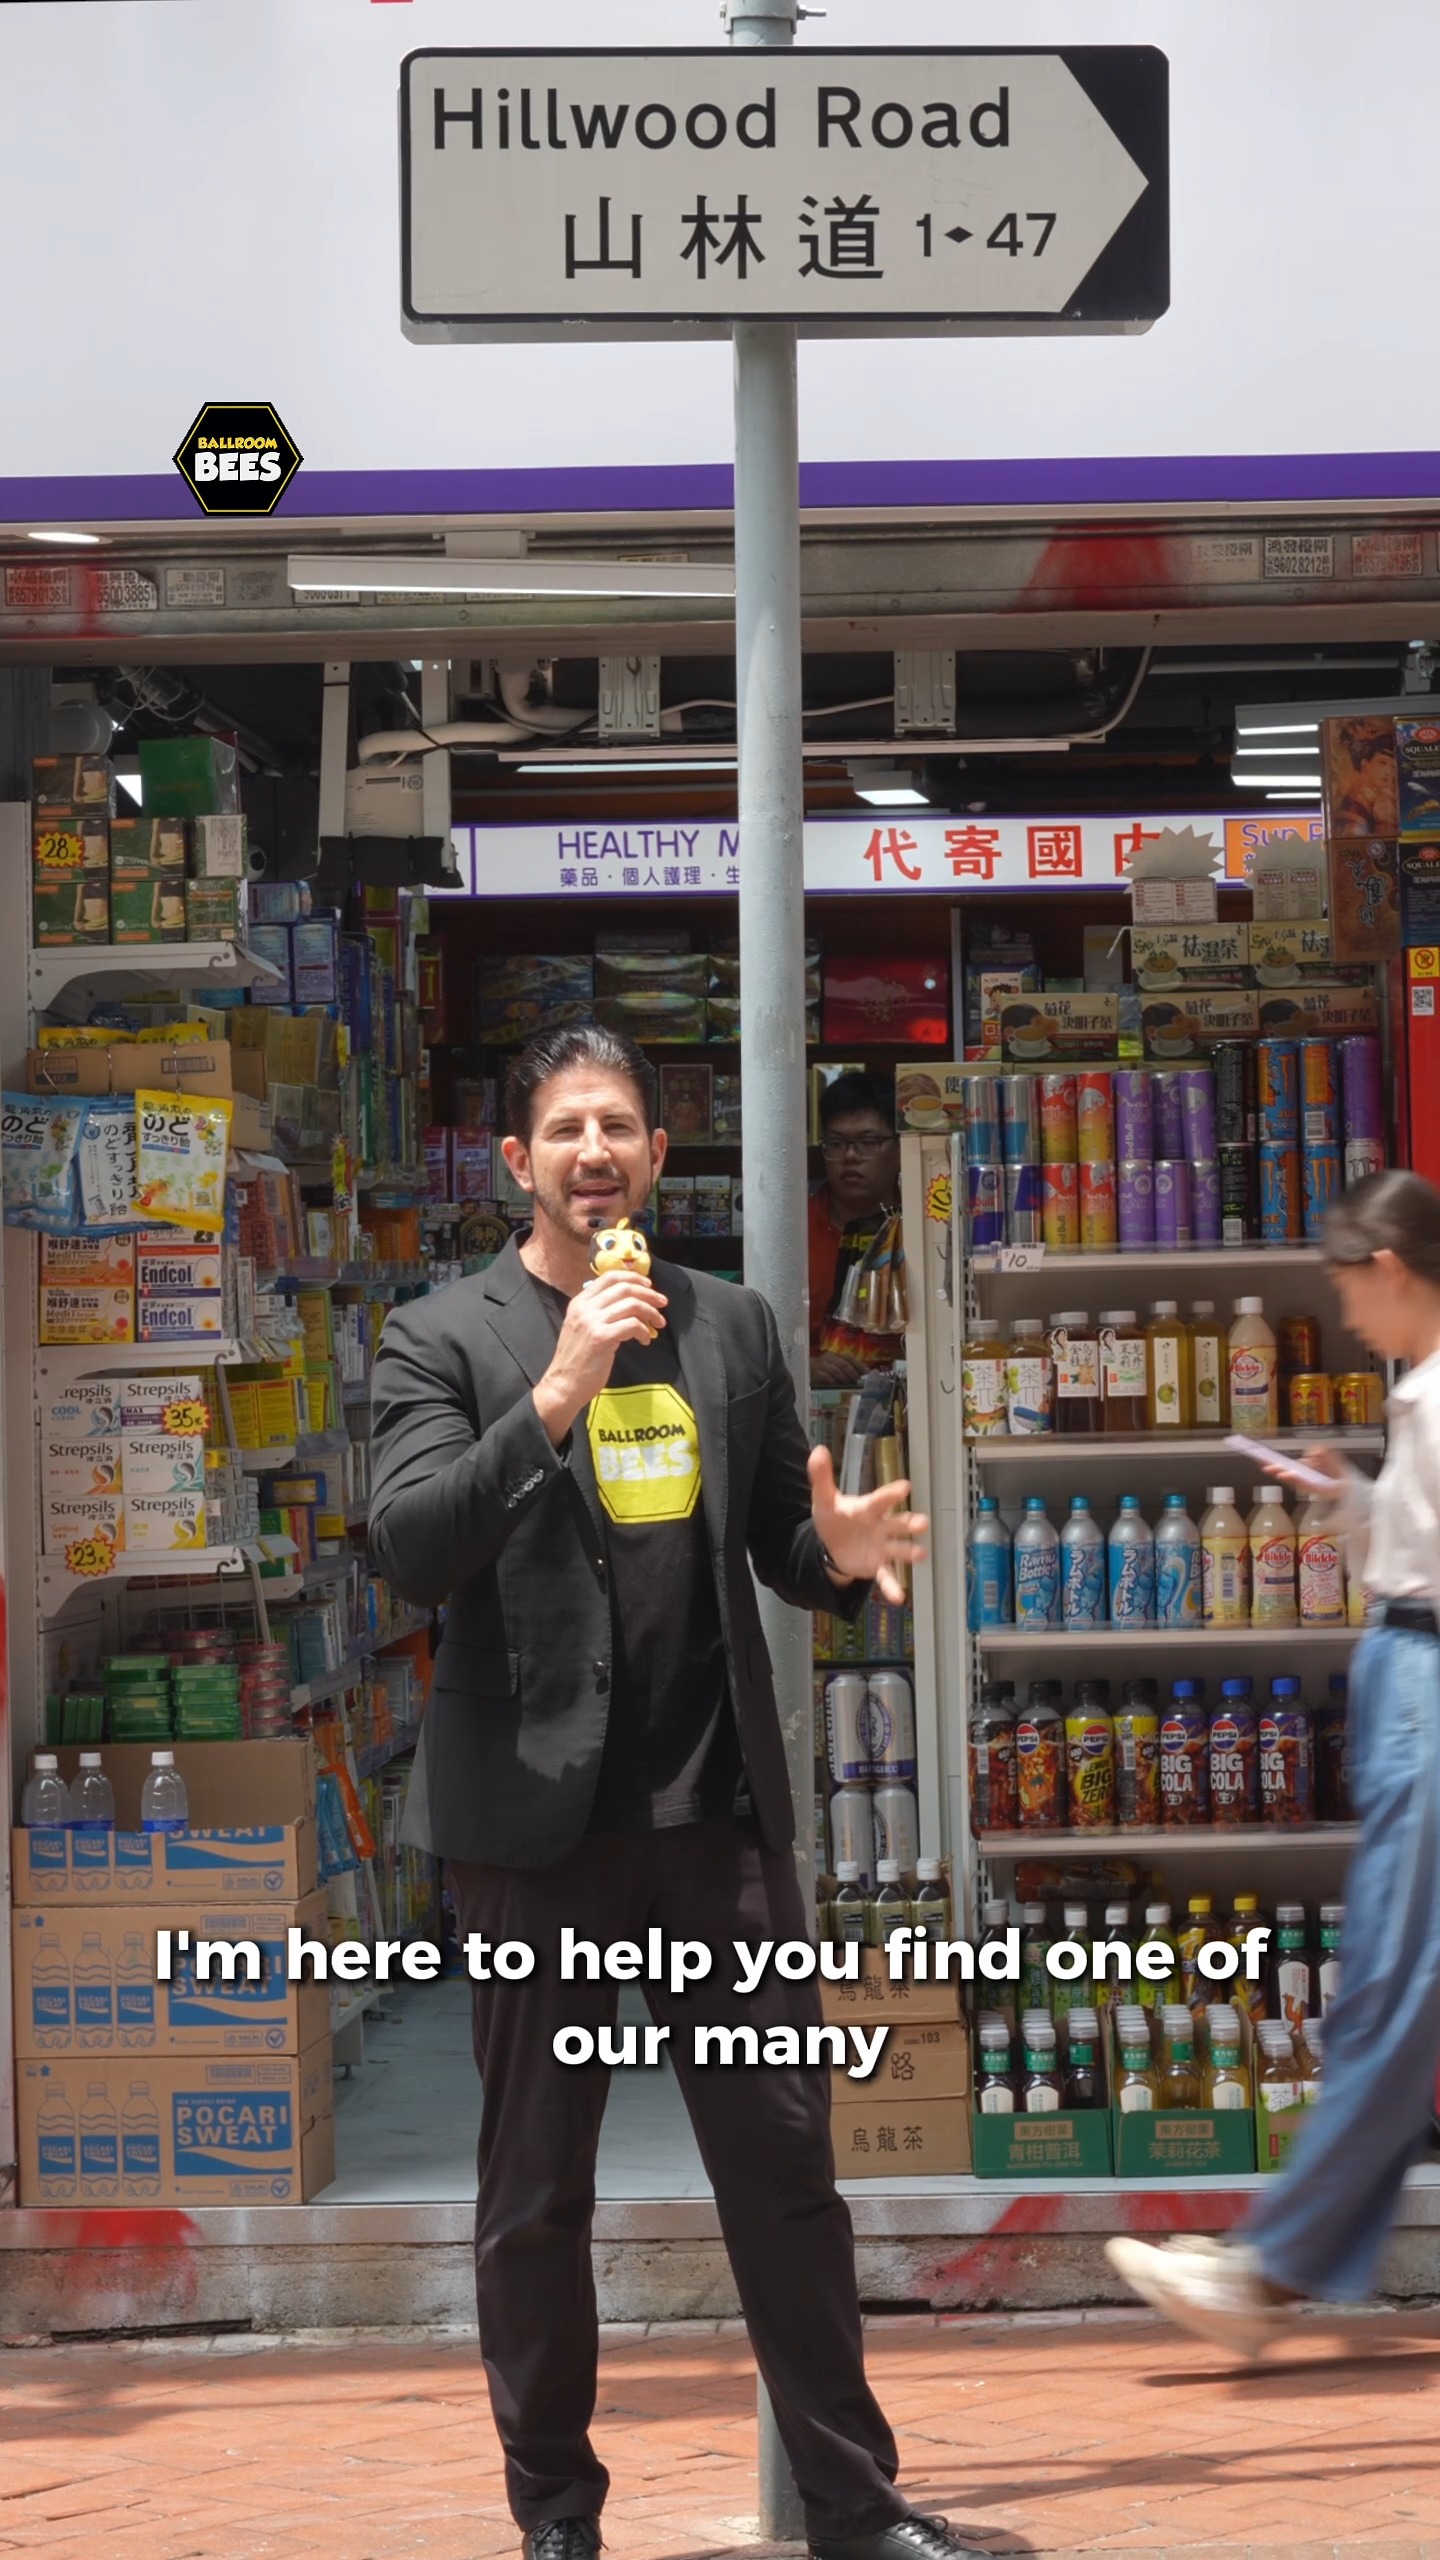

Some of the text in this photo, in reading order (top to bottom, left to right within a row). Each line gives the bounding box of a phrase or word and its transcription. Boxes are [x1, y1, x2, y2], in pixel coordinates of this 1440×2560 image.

[433, 86, 1011, 150] Hillwood Road
[564, 193, 1057, 280] 山林道 1 47
[1274, 556, 1323, 573] 96028212
[44, 837, 69, 859] 28
[557, 830, 701, 860] HEALTHY
[1008, 1252, 1027, 1268] 10
[142, 1265, 192, 1283] Endcol
[142, 1308, 193, 1325] Endcol
[60, 1383, 112, 1400] repsils
[127, 1382, 192, 1398] Strepsils
[598, 1424, 686, 1443] BALLROOM
[49, 1442, 113, 1458] Strepsils
[129, 1441, 193, 1456] Strepsils
[598, 1440, 694, 1482] BEES
[51, 1500, 115, 1516] Strepsils
[131, 1498, 195, 1513] Strepsils
[1017, 1735, 1037, 1743] PEPSI
[1083, 1735, 1108, 1743] PEPSI
[1162, 1733, 1185, 1741] PEPSI
[1212, 1732, 1237, 1740] PEPSI
[1161, 1754, 1192, 1773] BIG
[1210, 1753, 1244, 1772] BIG
[1080, 1769, 1111, 1790] BIG
[1161, 1773, 1192, 1791] COLA
[1210, 1772, 1244, 1790] COLA
[177, 2105, 287, 2125] POCARI
[177, 2126, 277, 2145] SWEAT
[851, 2125, 924, 2152] 烏龍茶
